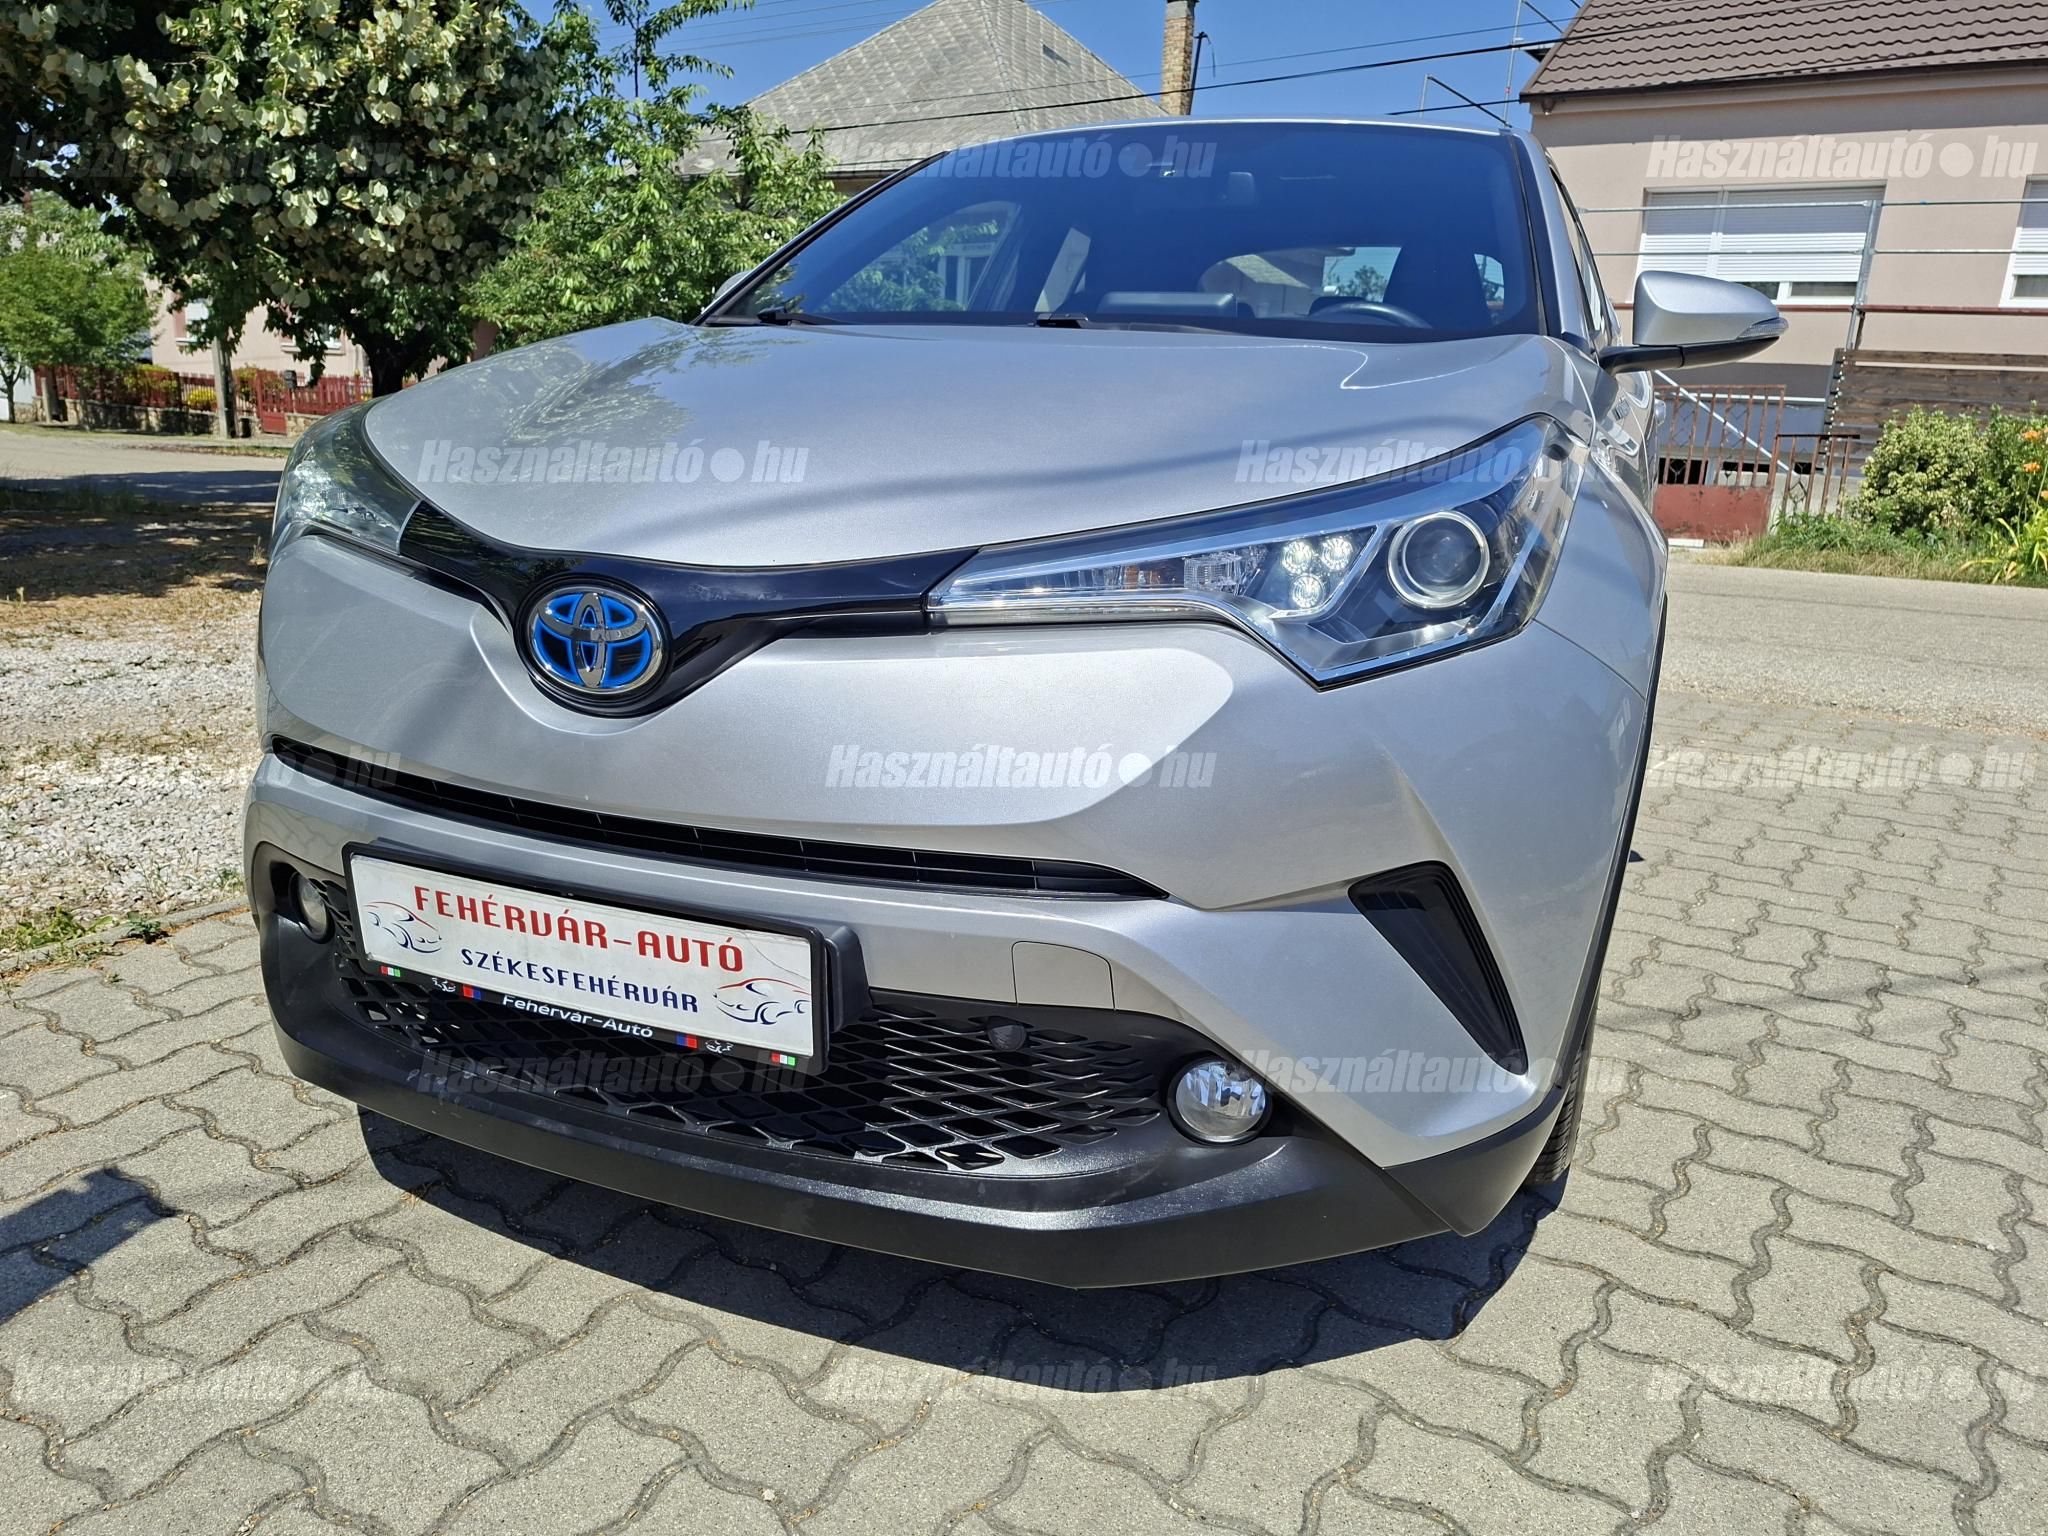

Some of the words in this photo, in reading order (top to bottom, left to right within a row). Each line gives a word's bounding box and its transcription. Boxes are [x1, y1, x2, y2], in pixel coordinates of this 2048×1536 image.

[414, 886, 744, 973] FEHÉRVÁR-AUTÓ
[461, 949, 698, 1013] SZÉKESFEHÉRVÁR
[502, 995, 654, 1038] Fehérvár-Autó
